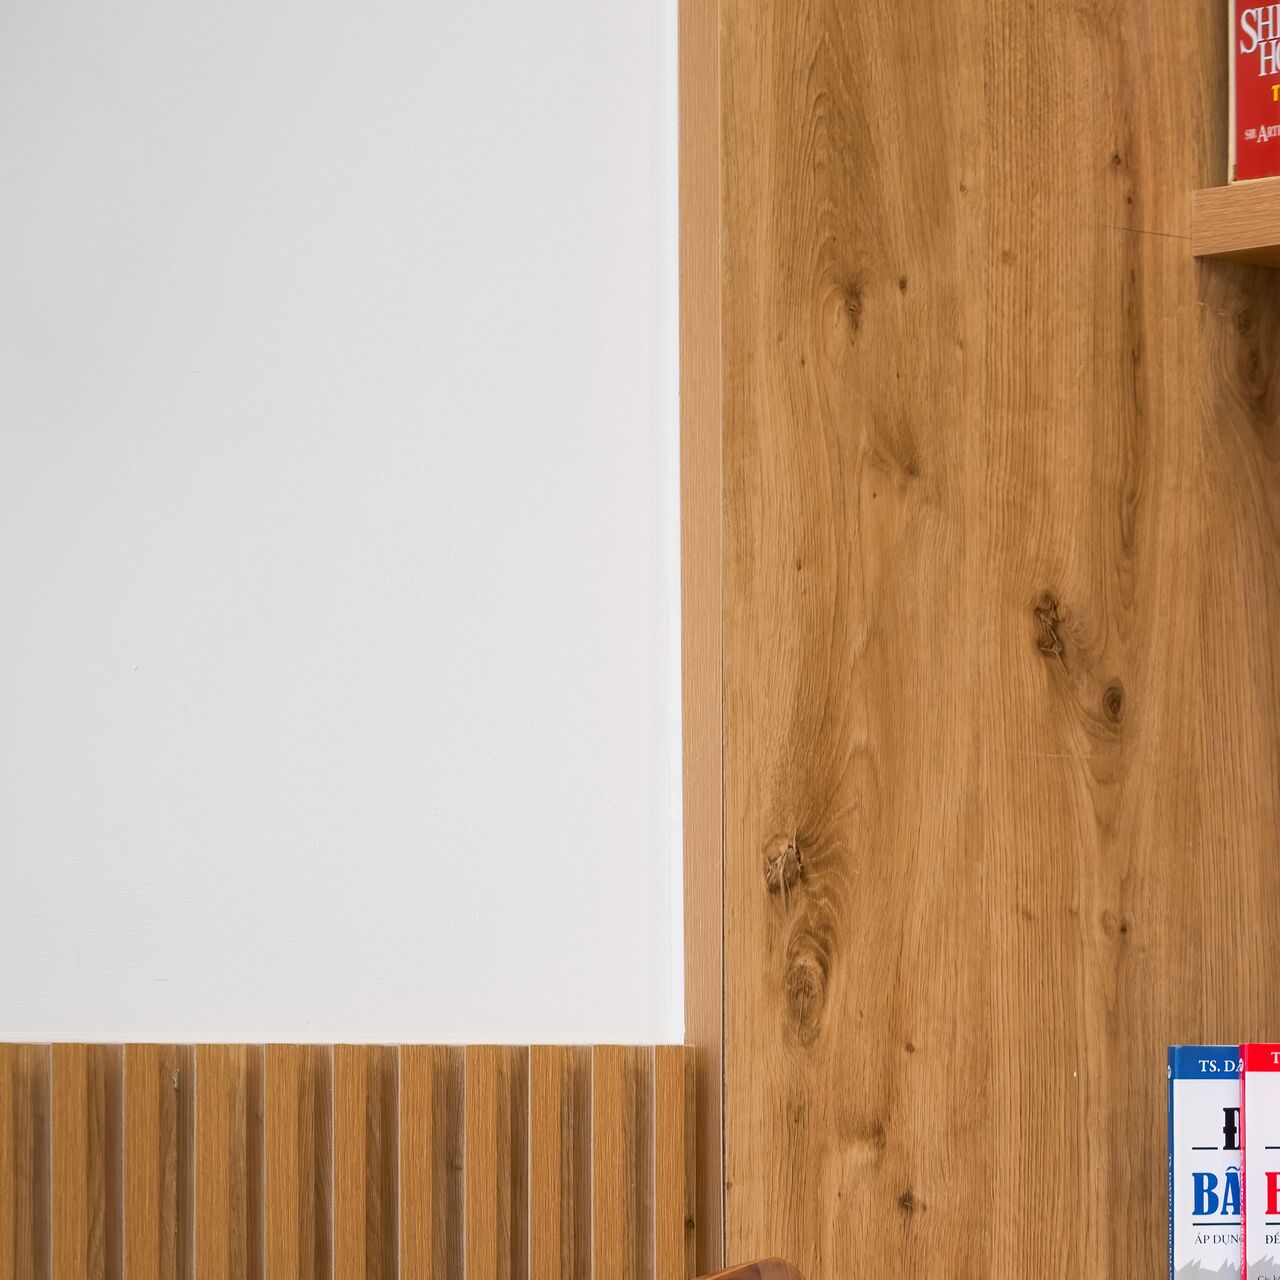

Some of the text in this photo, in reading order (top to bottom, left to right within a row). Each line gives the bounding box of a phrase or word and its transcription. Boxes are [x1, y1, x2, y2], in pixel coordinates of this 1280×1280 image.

[1244, 128, 1257, 140] SIR
[1199, 1060, 1220, 1072] TS.
[1195, 1232, 1240, 1246] ÁP DỤN
